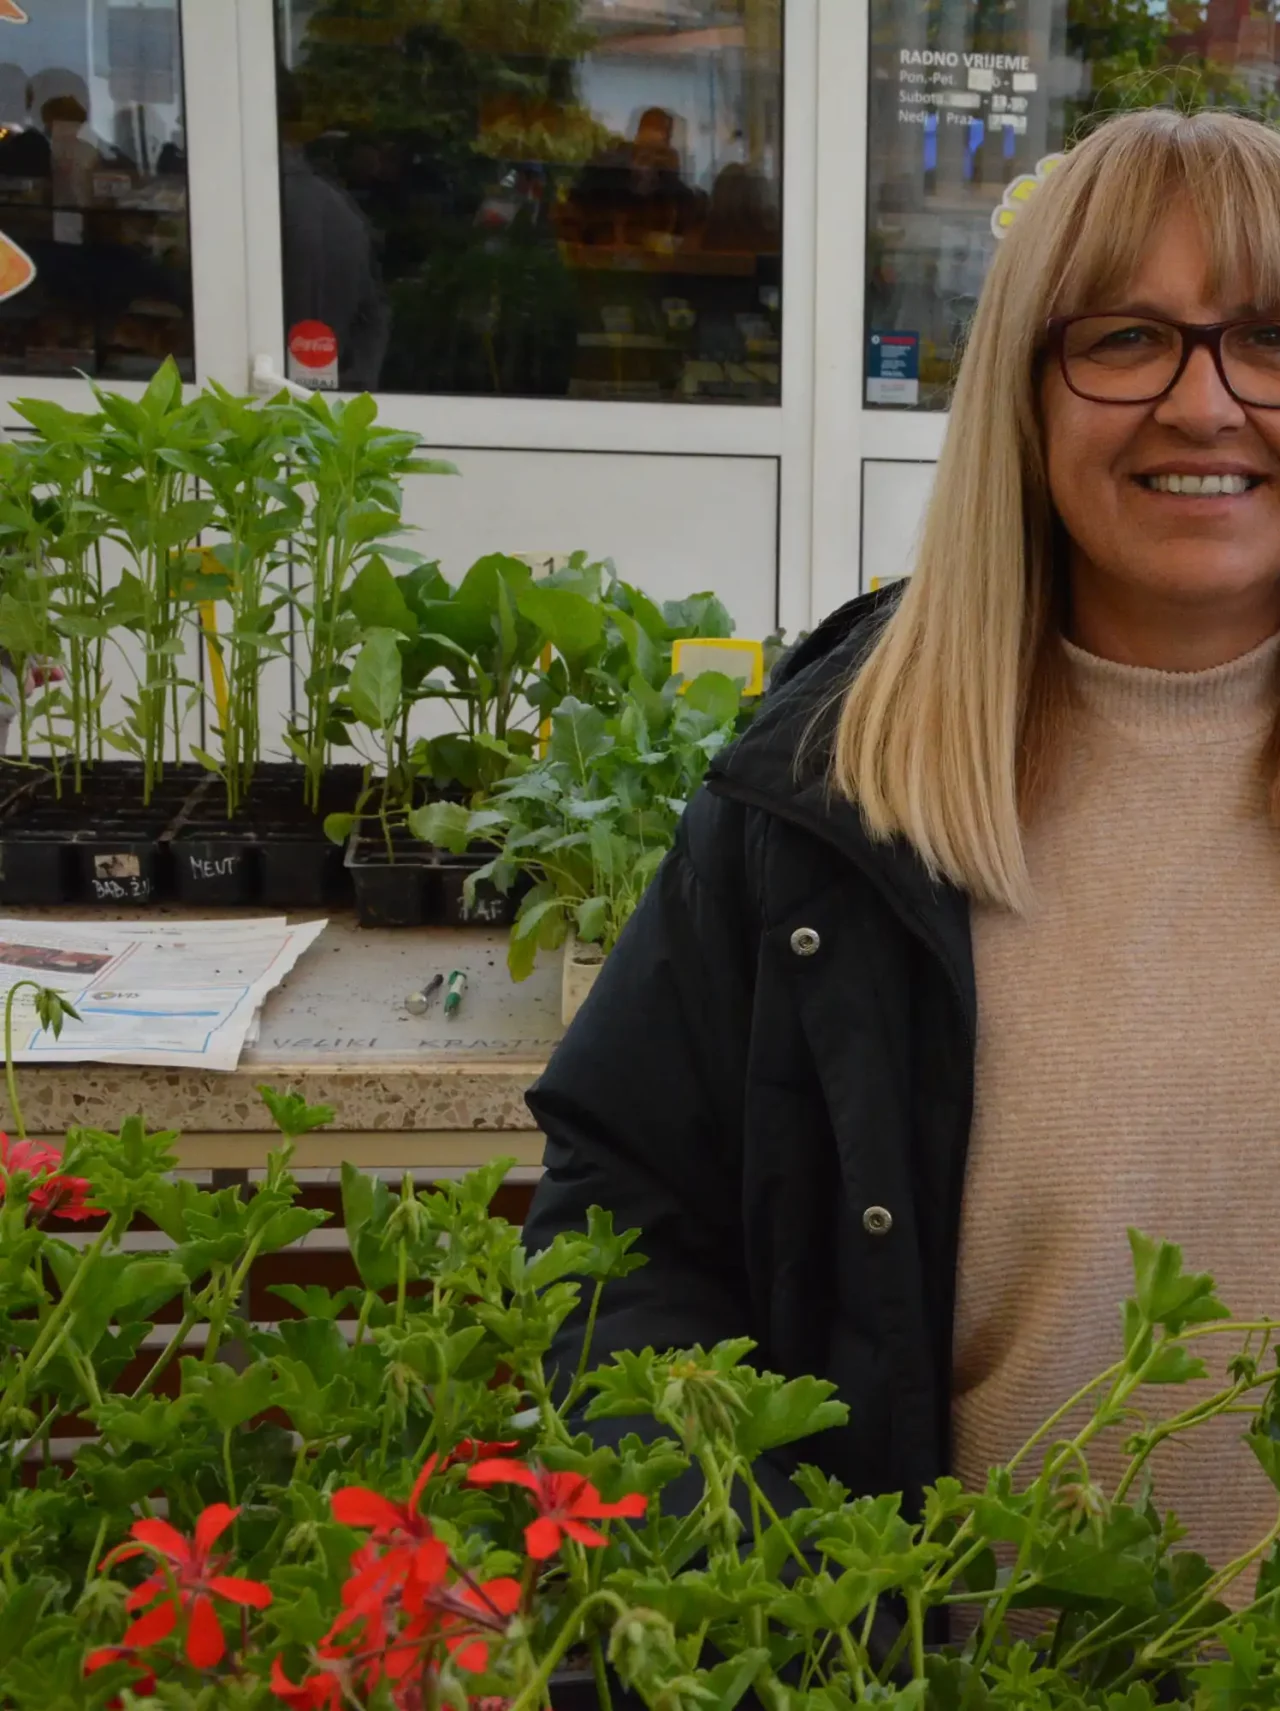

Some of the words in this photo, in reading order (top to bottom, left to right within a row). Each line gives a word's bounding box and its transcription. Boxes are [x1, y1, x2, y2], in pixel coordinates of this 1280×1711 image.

[899, 49, 959, 67] RADNO
[963, 52, 1031, 71] VRIJEME
[273, 1037, 378, 1049] VELIKI
